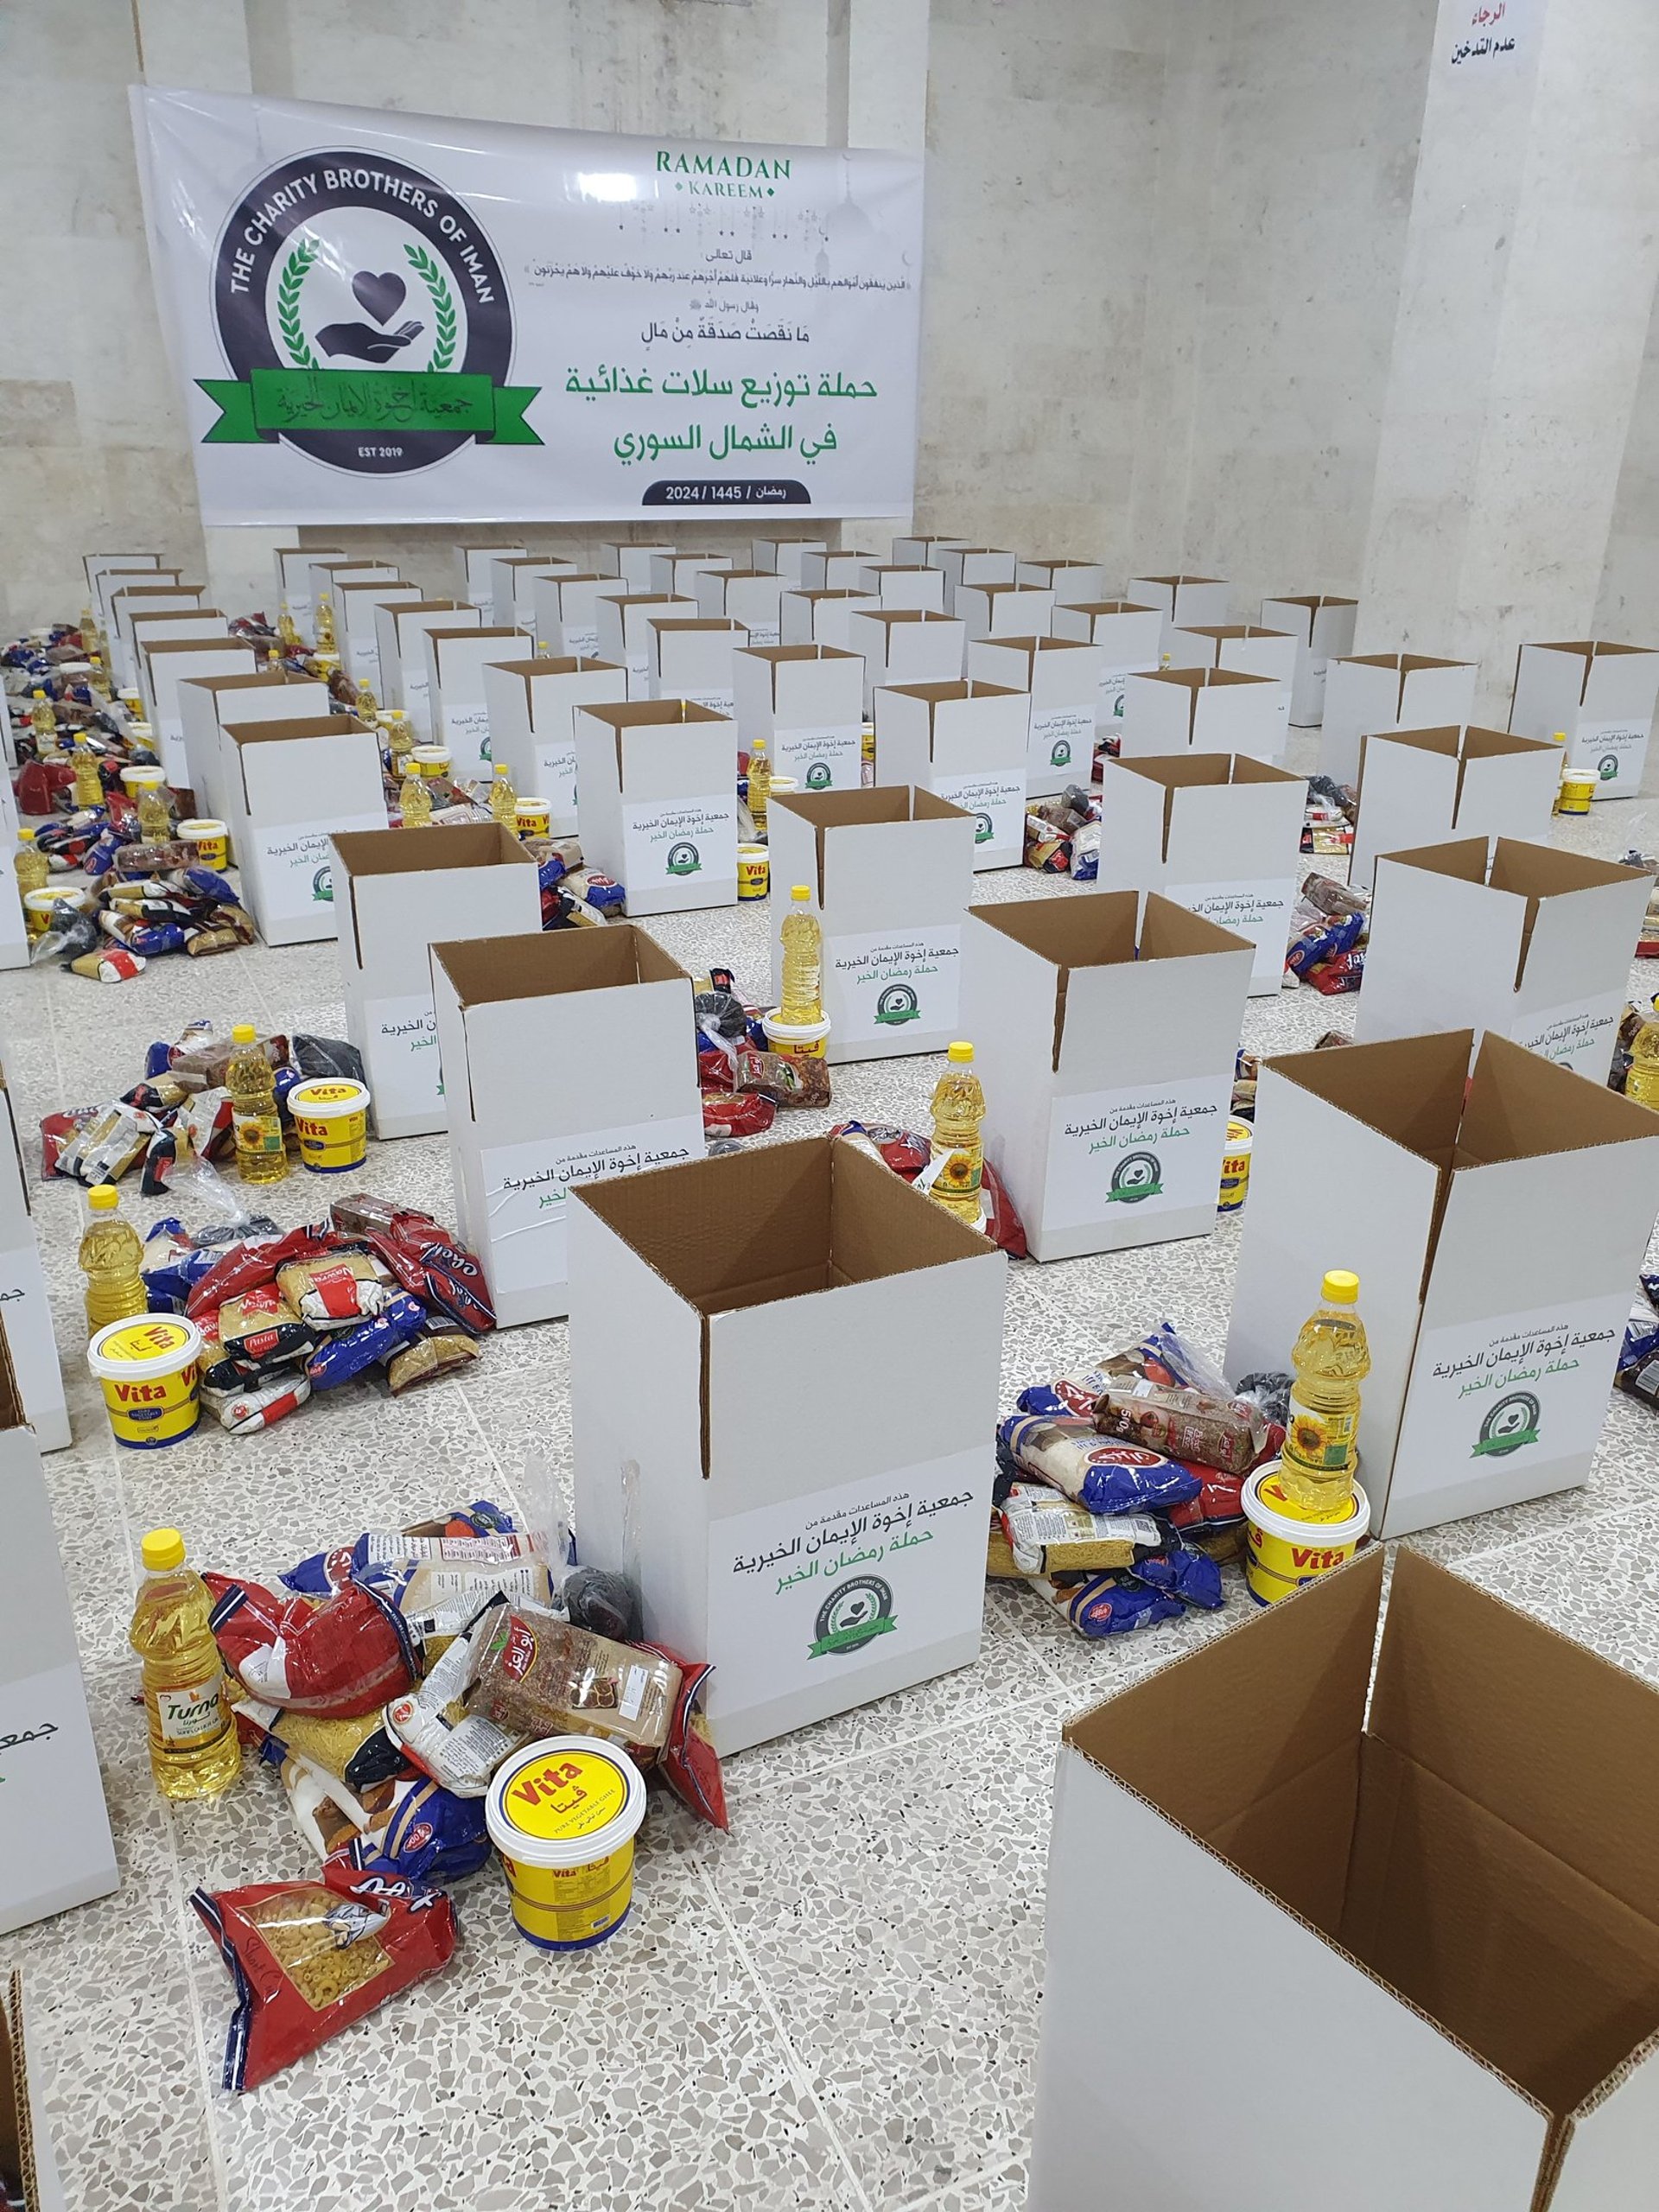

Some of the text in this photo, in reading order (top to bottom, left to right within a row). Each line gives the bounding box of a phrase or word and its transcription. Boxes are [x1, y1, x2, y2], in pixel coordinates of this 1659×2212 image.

[1452, 36, 1515, 64] عدم التدخين
[657, 150, 791, 180] RAMADAN
[689, 181, 763, 199] KAREEM
[231, 168, 494, 305] THE CHARITY BROTHERS OF IMAN
[735, 249, 753, 264] قال
[565, 364, 878, 409] حملة توزيع سلات غذائية
[358, 447, 404, 458] EST 2019
[613, 422, 838, 466] في الشمال السوري
[665, 486, 699, 500] 2024
[711, 486, 741, 499] 1445
[755, 486, 786, 499] رمضان
[836, 955, 869, 970] الخيرية
[871, 951, 902, 966] الإيمان
[905, 949, 926, 963] إخوة
[928, 947, 959, 959] جمعية
[856, 964, 938, 984] حملة رمضان الخير
[381, 1019, 423, 1036] الخيرية
[410, 1034, 436, 1052] الخير
[296, 1116, 328, 1135] Vita
[1065, 1104, 1217, 1137] جمعية إخوة الإيمان الخيرية
[1089, 1126, 1191, 1154] حملة رمضان الخير
[504, 1147, 690, 1191] جمعية إخوة الإيمان الخيرية
[539, 1187, 567, 1209] لخير
[143, 1326, 175, 1350] Vita
[1433, 1328, 1616, 1378] جمعية إخوة الإيمان الخيرية
[114, 1363, 197, 1403] Vita Vi
[1459, 1357, 1580, 1399] حملة رمضان الخير
[805, 1492, 910, 1530] هذه المساعدات مقدمة من
[733, 1491, 974, 1574] جمعية إخوة الإيمان الخيرية
[775, 1529, 934, 1595] حملة رمضان الخير
[1292, 1547, 1344, 1569] Vita
[507, 1625, 535, 1676] أبو العز
[512, 1762, 583, 1806] Vita
[553, 1869, 578, 1878] Vita
